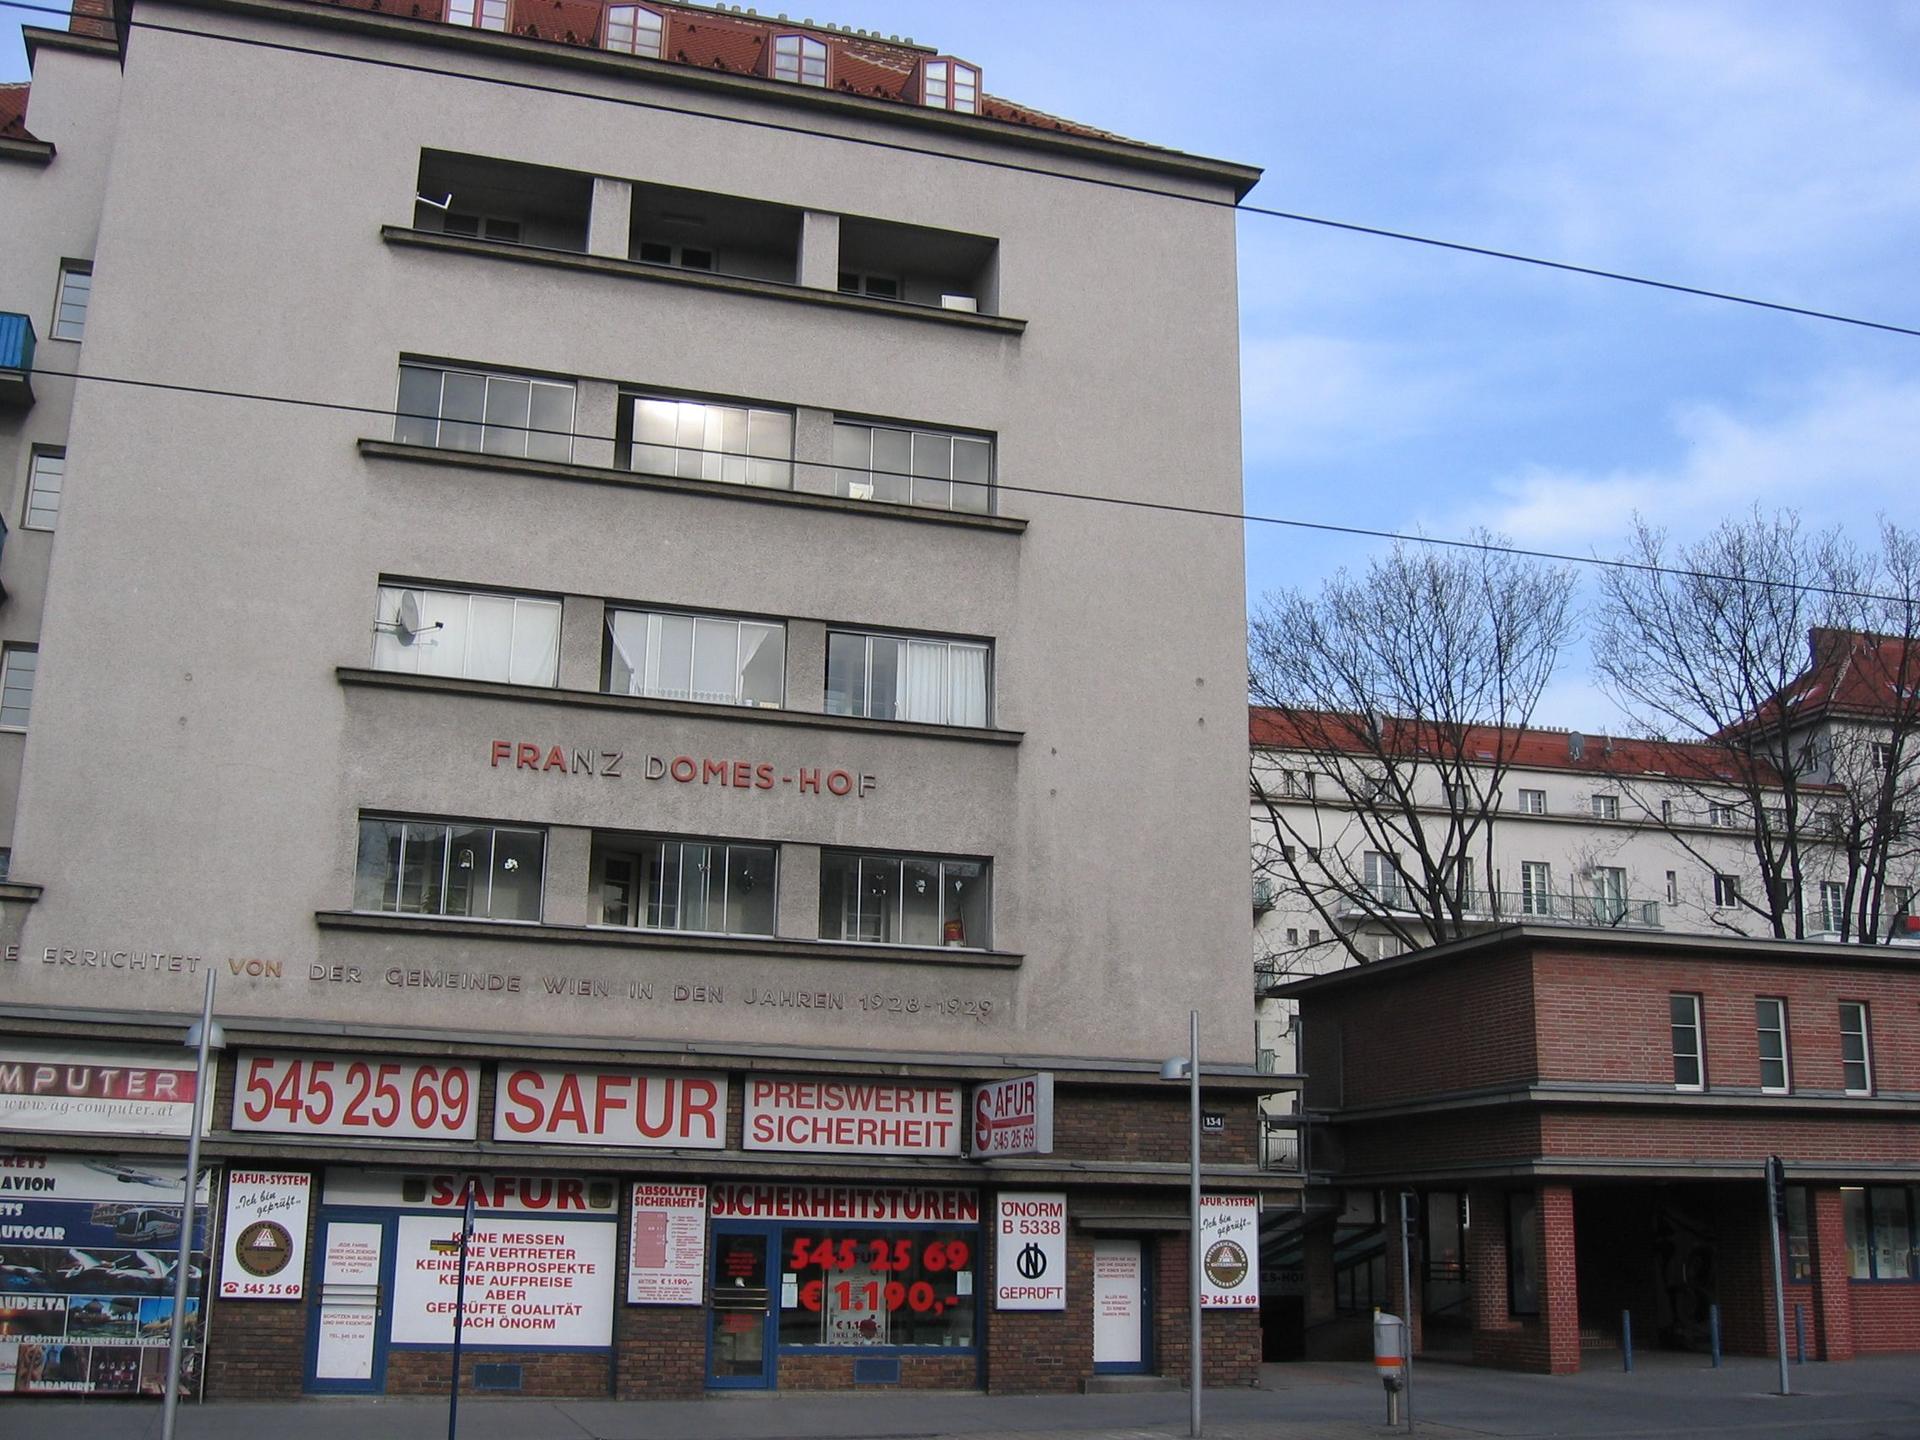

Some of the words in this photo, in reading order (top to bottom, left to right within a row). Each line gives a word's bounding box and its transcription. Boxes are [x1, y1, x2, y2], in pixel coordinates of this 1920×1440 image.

[490, 740, 624, 777] FRANZ
[644, 753, 877, 797] DOMES-HOF
[42, 947, 201, 973] ERRICHTET
[228, 957, 283, 979] VON
[309, 963, 363, 984] DER
[385, 966, 521, 993] GEMEINDE
[542, 976, 608, 997] WIEN
[629, 981, 655, 1000] IN
[674, 983, 724, 1004] DEN
[743, 987, 844, 1010] JAHREN
[858, 994, 994, 1017] 1928-1929
[244, 1058, 334, 1125] 545
[343, 1062, 402, 1127] 25
[411, 1064, 469, 1130] 69
[753, 1080, 953, 1115] PREISWERTE
[2, 1100, 174, 1118] www.ag-computer.at
[505, 1070, 718, 1139] SAFUR
[752, 1114, 953, 1149] SICHERHEIT
[994, 1131, 1009, 1150] 545
[1011, 1129, 1021, 1148] 25
[1024, 1128, 1035, 1148] 69
[1, 1176, 56, 1191] AVION
[231, 1172, 309, 1186] SAFUR-SYSTEM
[259, 1189, 276, 1203] bin
[431, 1173, 587, 1210] SAFUR
[635, 1185, 697, 1197] ABSOLUTE
[635, 1196, 697, 1208] SICHERHEIT
[712, 1184, 978, 1220] SICHERHEITSTÜREN
[1001, 1200, 1063, 1217] ÖNORM
[1200, 1197, 1255, 1206] AFUR-SYSTEM
[1219, 1213, 1231, 1223] bin
[1003, 1220, 1013, 1234] B
[1019, 1220, 1061, 1235] 5338
[452, 1232, 498, 1244] KINE
[502, 1234, 565, 1245] MESSEN
[438, 1246, 486, 1258] KENE
[489, 1247, 576, 1260] VERTRETER
[790, 1238, 857, 1270] 545
[870, 1239, 912, 1271] 25
[923, 1240, 969, 1271] 69
[416, 1259, 460, 1271] KEINE
[467, 1260, 596, 1275] FARBPROSPEKTE
[243, 1283, 264, 1294] 545
[268, 1284, 281, 1294] 25
[285, 1284, 300, 1295] 69
[439, 1275, 485, 1286] KENE
[489, 1276, 573, 1288] AUFPREISE
[485, 1290, 527, 1301] ABER
[800, 1280, 824, 1312] €
[834, 1280, 959, 1316] 1.190,-
[1000, 1286, 1063, 1300] GEPRÜFT
[1213, 1295, 1229, 1305] 545
[1232, 1295, 1242, 1305] 25
[1245, 1295, 1256, 1305] 69
[511, 1302, 583, 1316] QUALITÄT
[499, 1315, 556, 1329] ÖNORM
